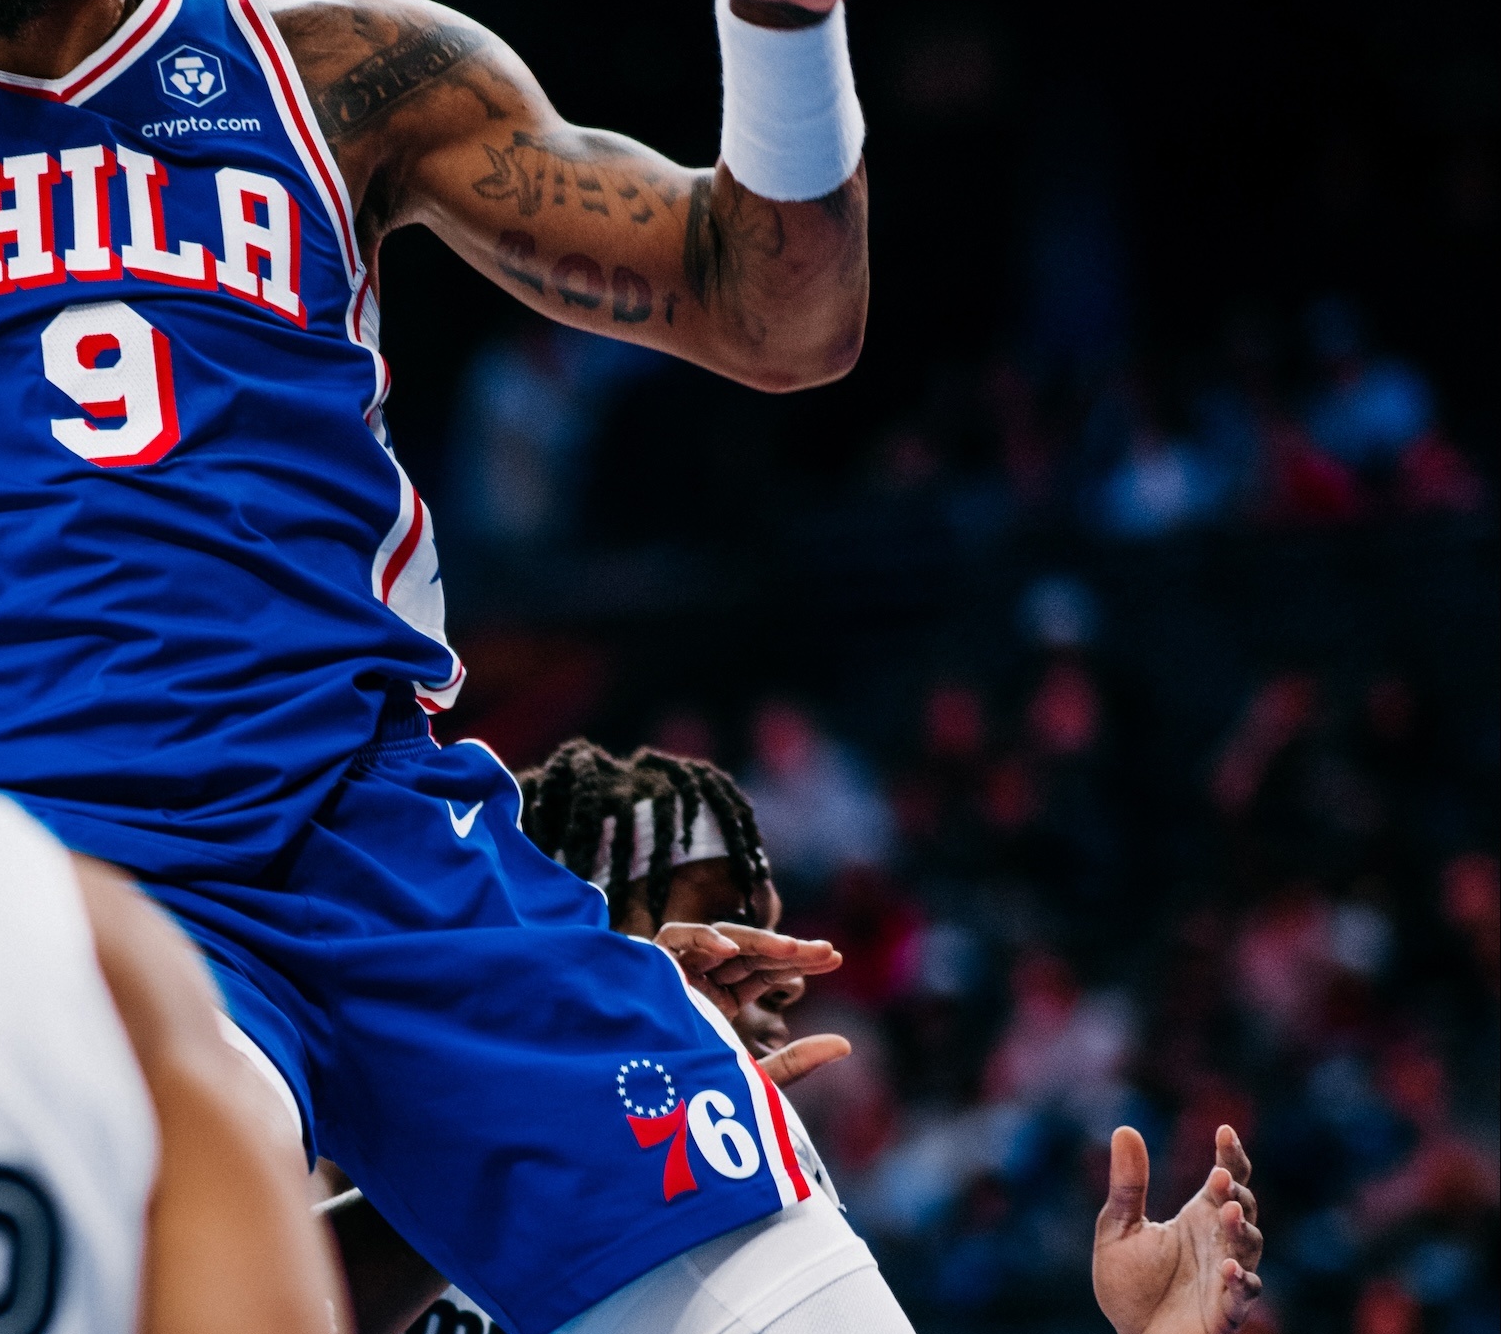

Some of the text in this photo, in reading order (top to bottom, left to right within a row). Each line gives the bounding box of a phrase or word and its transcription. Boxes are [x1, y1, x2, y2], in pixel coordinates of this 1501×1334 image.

[141, 116, 262, 138] crypto.com
[40, 299, 182, 469] 9
[625, 1088, 761, 1203] 76
